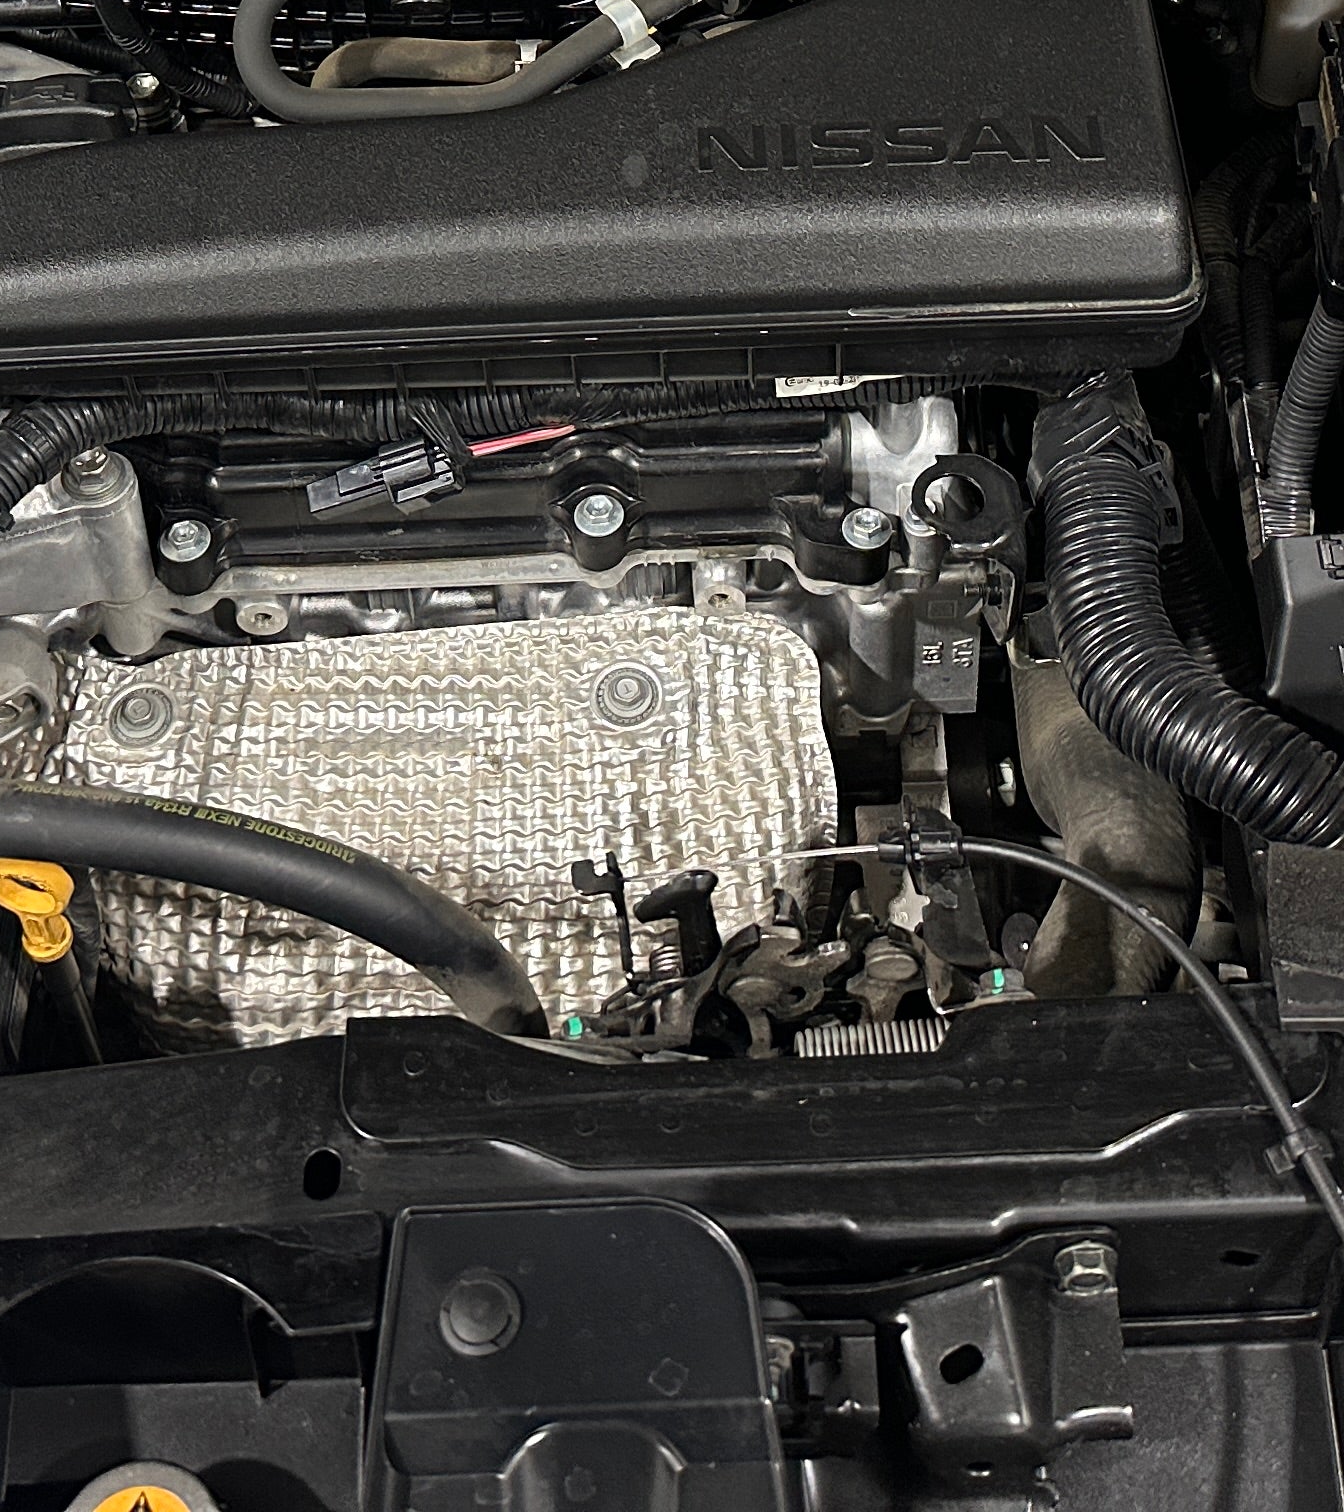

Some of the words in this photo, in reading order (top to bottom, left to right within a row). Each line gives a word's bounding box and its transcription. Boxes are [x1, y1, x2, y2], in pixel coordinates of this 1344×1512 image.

[697, 114, 1106, 173] NISSAN
[146, 799, 192, 818] R134a
[245, 818, 356, 864] BRIDGESTONE
